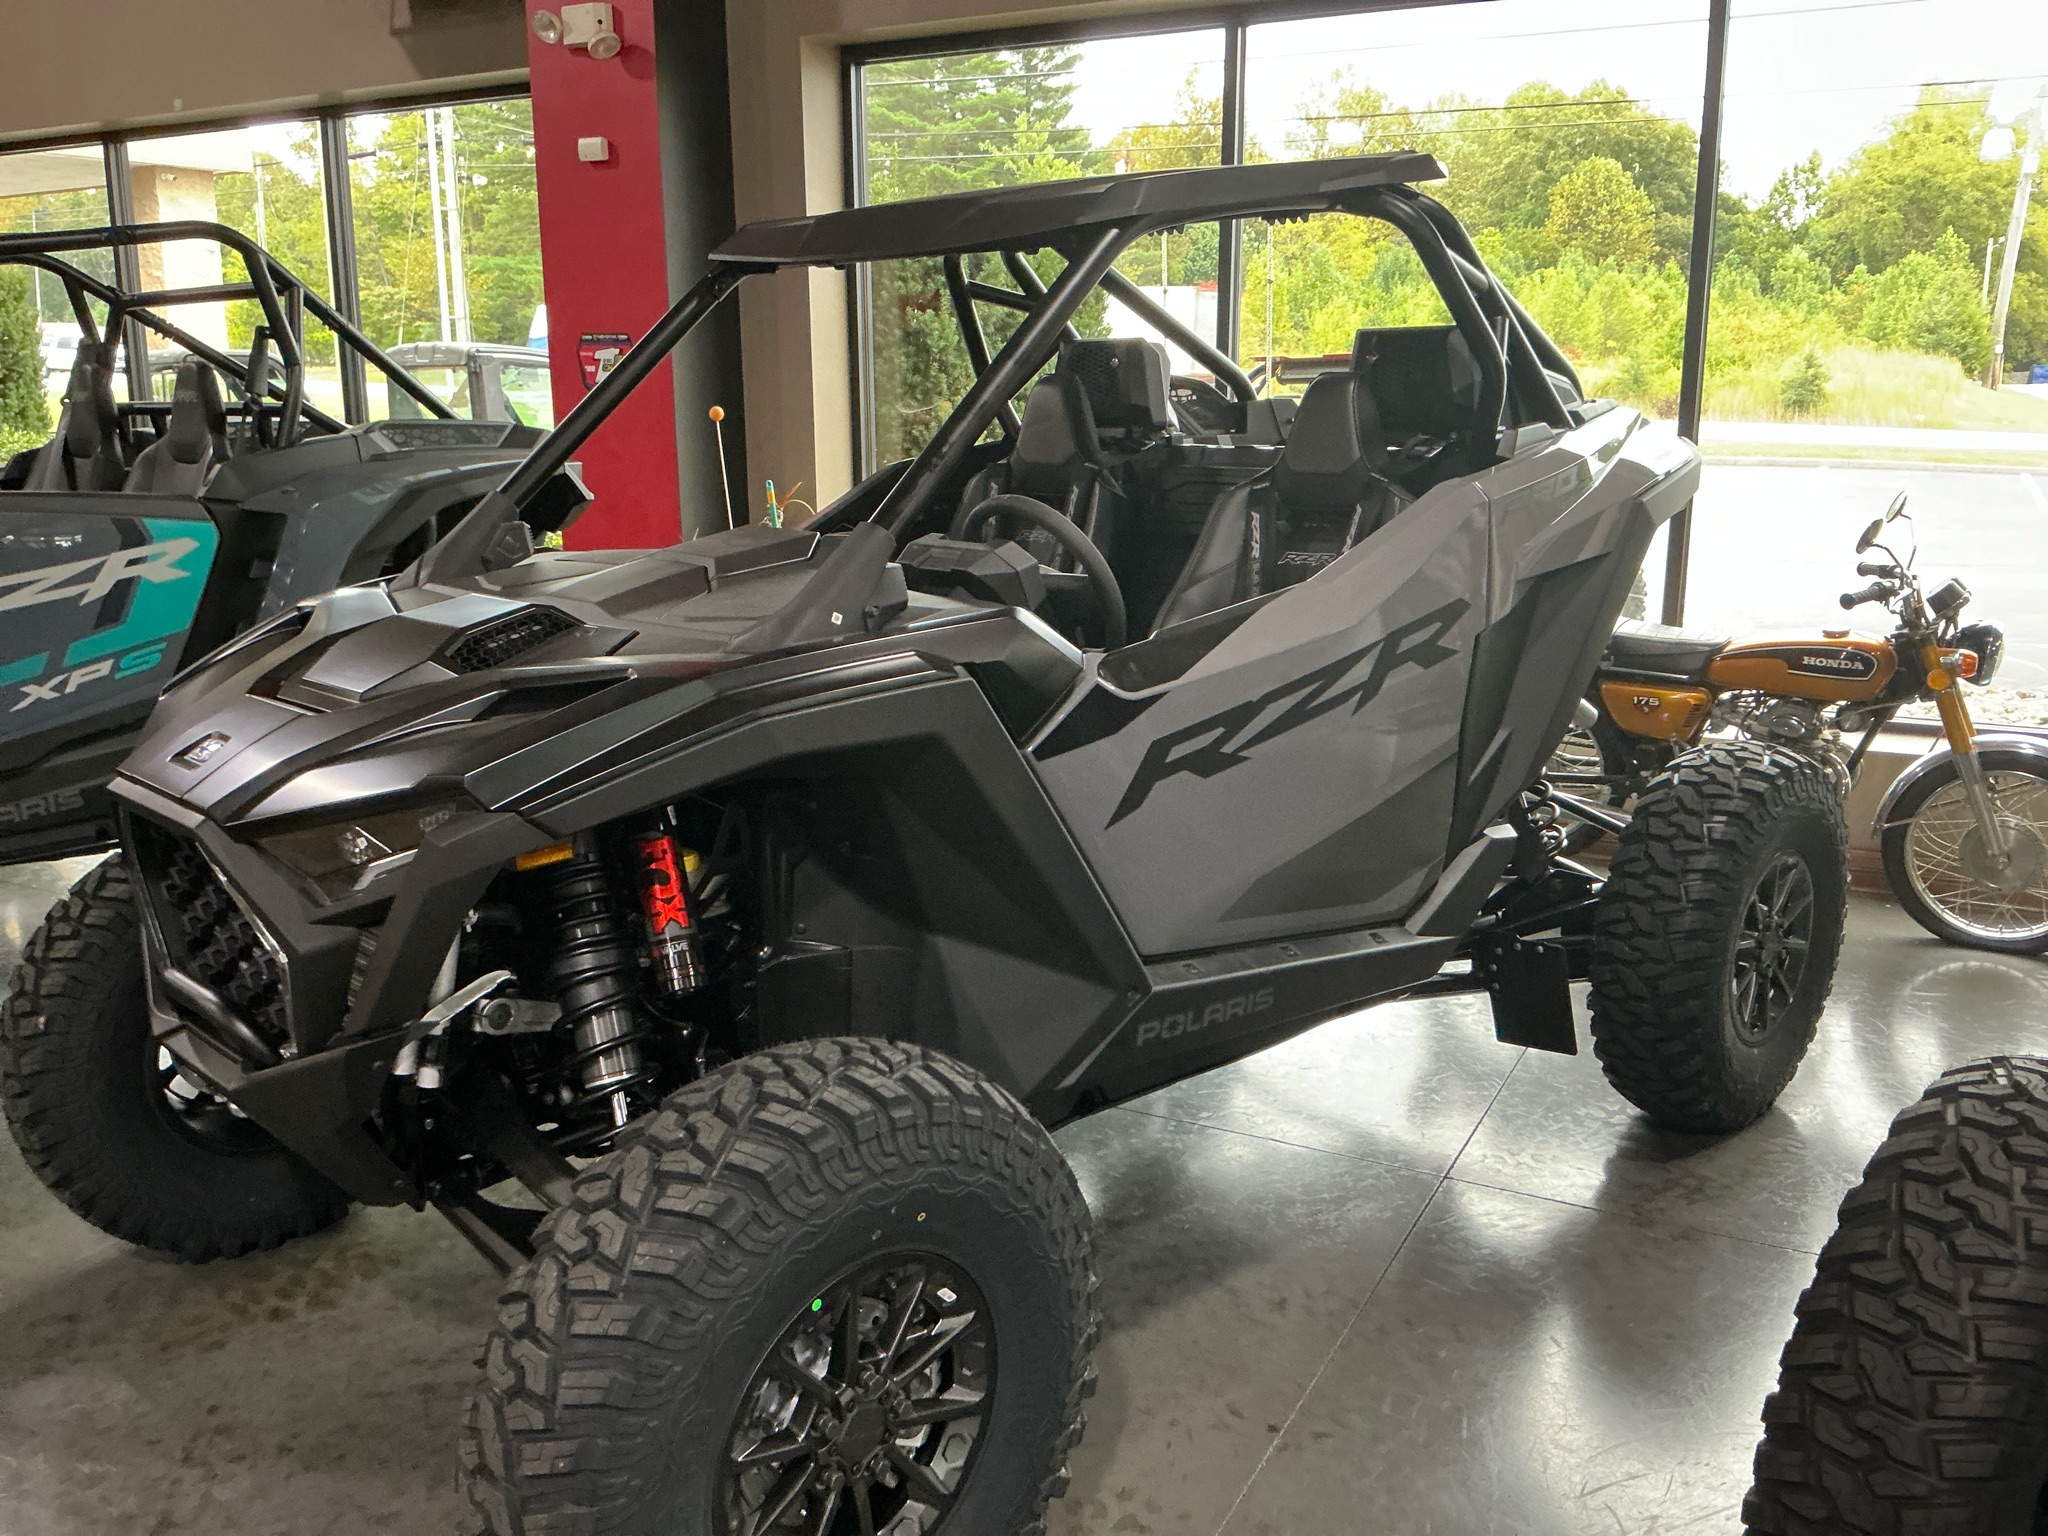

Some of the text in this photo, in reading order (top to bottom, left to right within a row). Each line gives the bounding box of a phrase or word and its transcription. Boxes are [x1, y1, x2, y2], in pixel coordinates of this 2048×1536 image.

[1802, 656, 1865, 670] HONDA
[1104, 597, 1472, 831] RZR
[1633, 696, 1660, 706] 175
[1136, 987, 1275, 1048] POLARIS
